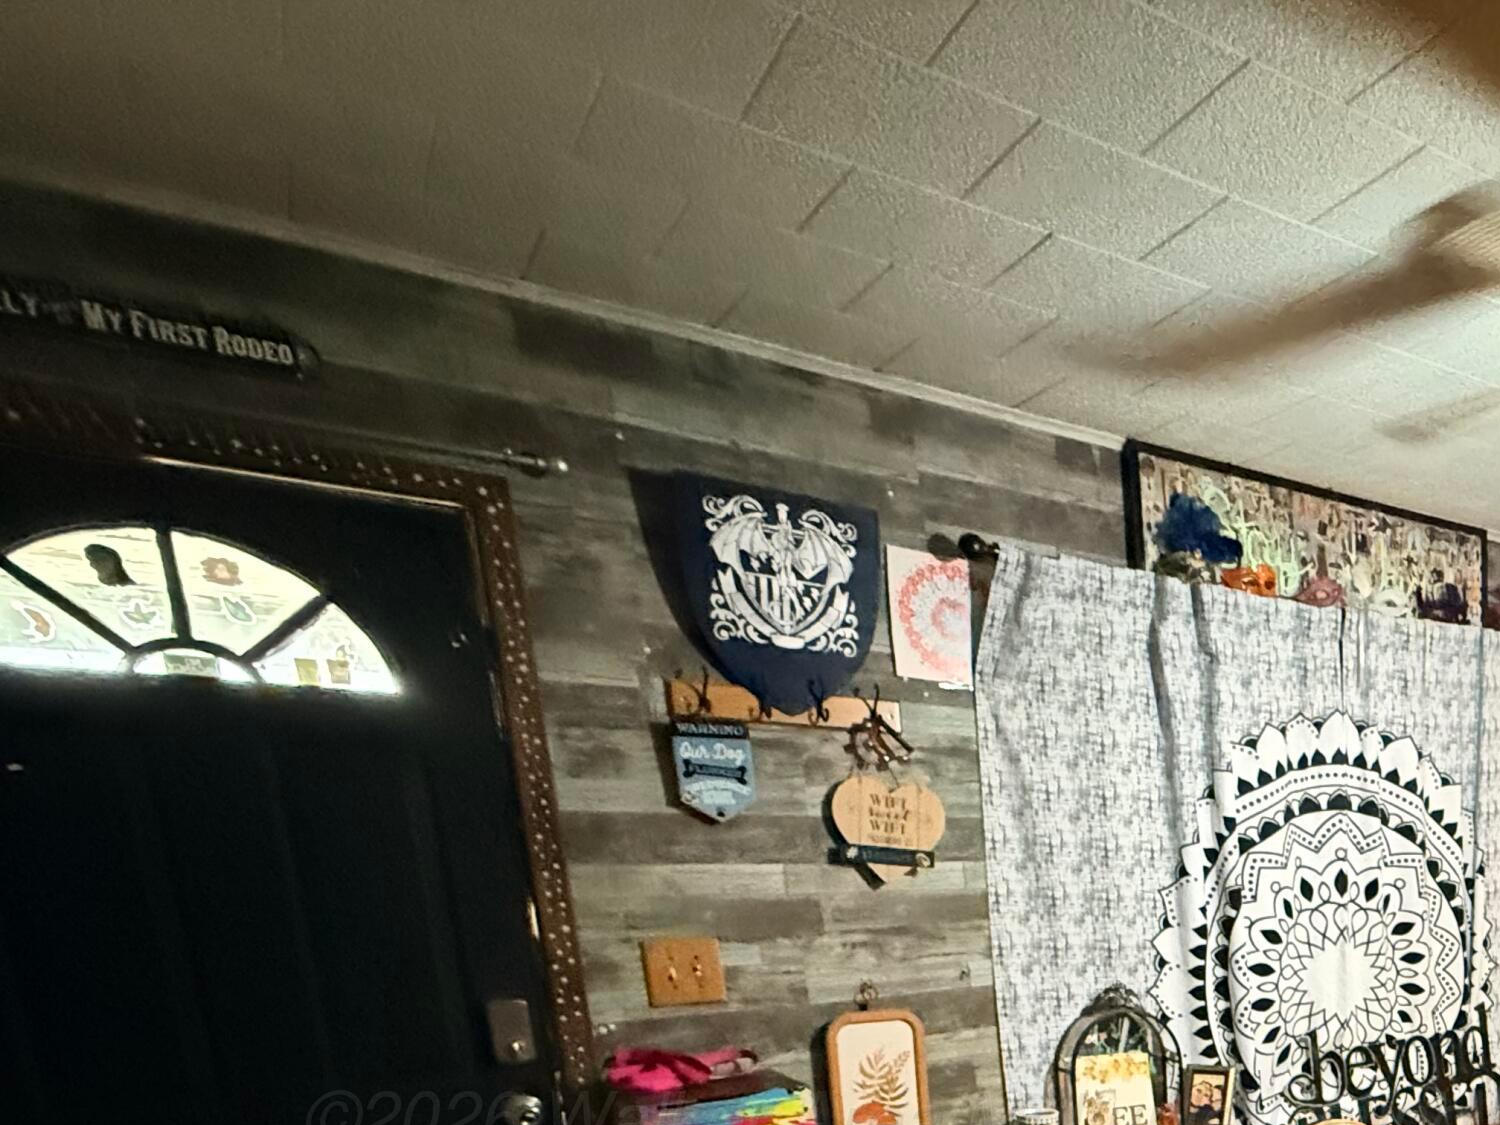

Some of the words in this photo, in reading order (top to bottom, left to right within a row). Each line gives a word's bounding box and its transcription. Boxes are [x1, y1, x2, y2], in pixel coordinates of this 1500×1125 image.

[81, 299, 122, 334] MY
[128, 308, 208, 349] FIRST
[211, 325, 294, 365] RODEO
[676, 722, 745, 736] WARNING
[680, 741, 709, 759] Our
[712, 742, 745, 766] Dog
[1284, 1002, 1496, 1119] beyond
